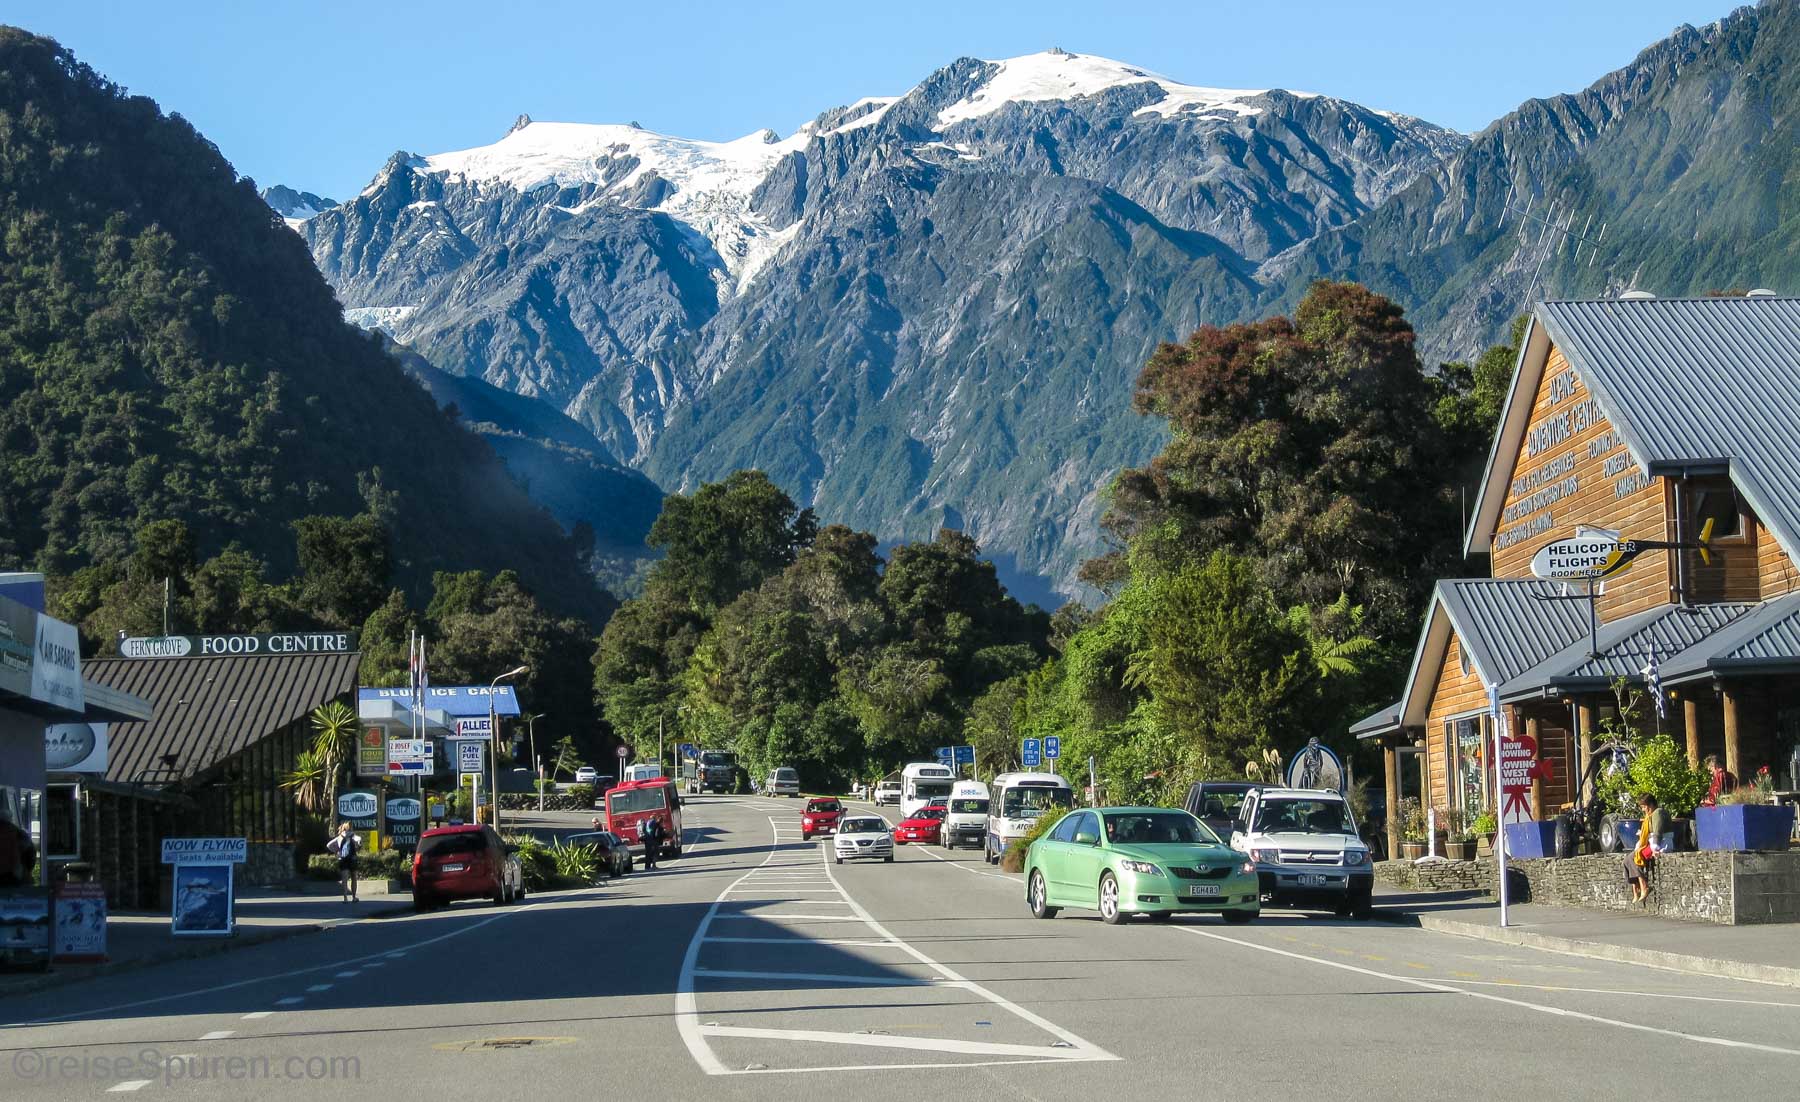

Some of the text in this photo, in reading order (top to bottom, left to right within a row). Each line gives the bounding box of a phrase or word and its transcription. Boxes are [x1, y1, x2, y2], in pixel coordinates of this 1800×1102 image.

[1550, 371, 1576, 406] ALPINE
[1528, 410, 1571, 458] ADVENTURE
[1548, 542, 1636, 555] HELICOPTER
[1549, 556, 1607, 568] FLIGHTS
[1551, 568, 1602, 578] BOOK HERE
[130, 639, 182, 656] FERN GROVE
[201, 634, 348, 654] FOOD CENTRE
[55, 645, 76, 672] SAFARIS
[431, 688, 457, 696] ICE
[467, 687, 508, 695] CAFE
[364, 728, 382, 747] 4
[1028, 741, 1034, 749] P
[1503, 742, 1521, 750] NOW
[1503, 769, 1528, 777] WEST
[1501, 777, 1531, 785] MOVIE
[393, 825, 414, 833] FOOD
[164, 839, 244, 851] NOW FLYING
[178, 851, 243, 862] Seats Available
